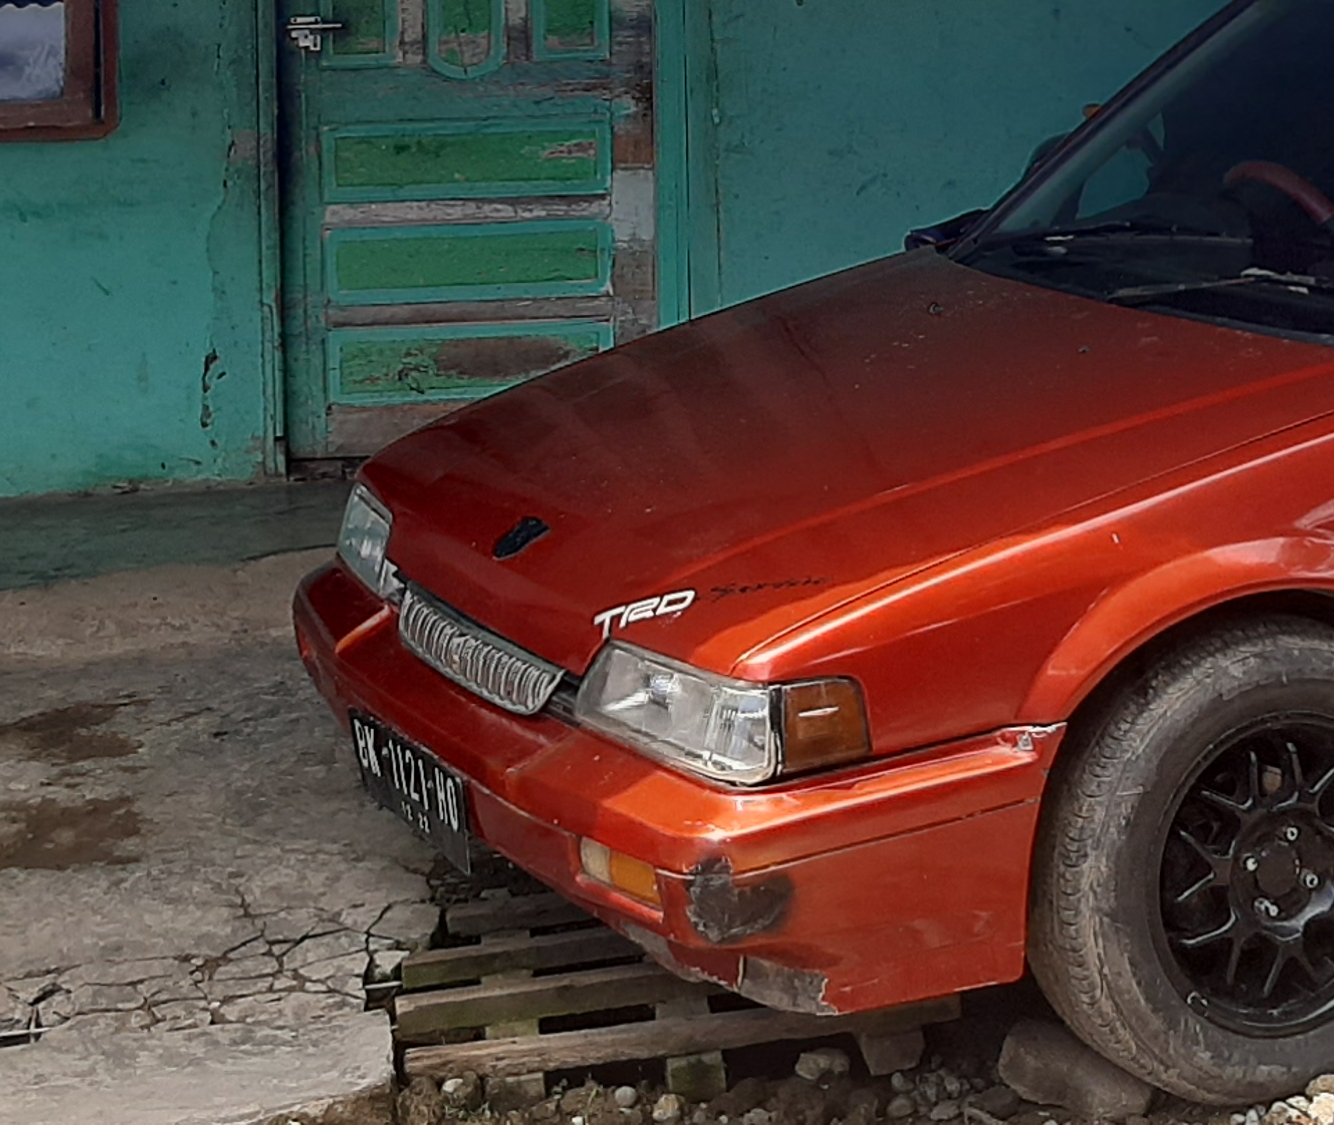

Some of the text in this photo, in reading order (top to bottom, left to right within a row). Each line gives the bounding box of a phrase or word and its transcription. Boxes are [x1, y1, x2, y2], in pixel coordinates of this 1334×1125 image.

[593, 589, 696, 640] TRD
[353, 718, 382, 777] BK
[388, 739, 429, 811] 1121
